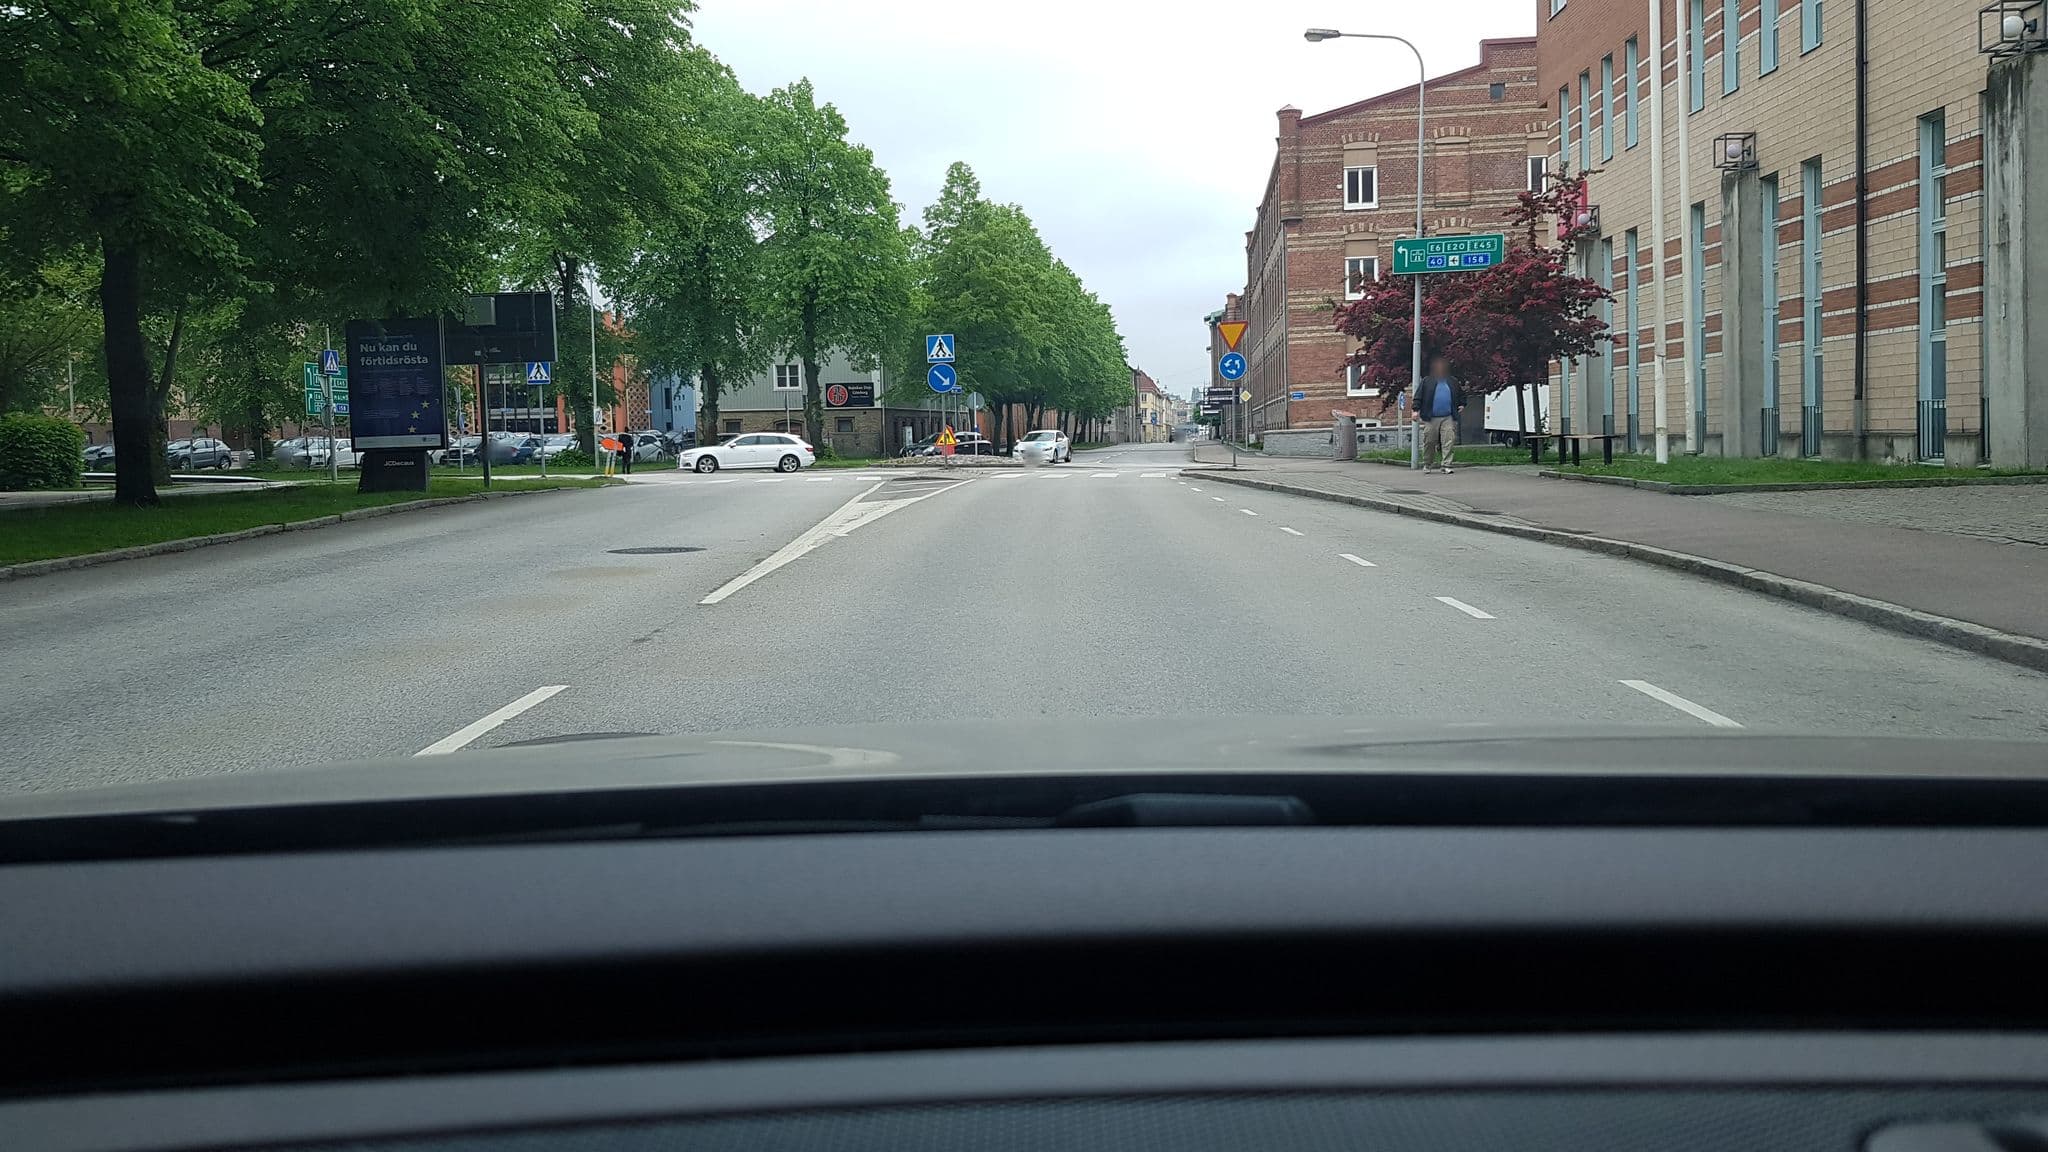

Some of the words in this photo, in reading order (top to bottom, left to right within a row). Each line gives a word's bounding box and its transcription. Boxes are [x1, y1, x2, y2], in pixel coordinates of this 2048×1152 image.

[1447, 243, 1465, 251] E20
[1473, 241, 1492, 249] E45
[360, 344, 376, 352] Nu
[378, 342, 400, 352] kan
[402, 342, 417, 351] du
[360, 355, 429, 366] förtidsrösta
